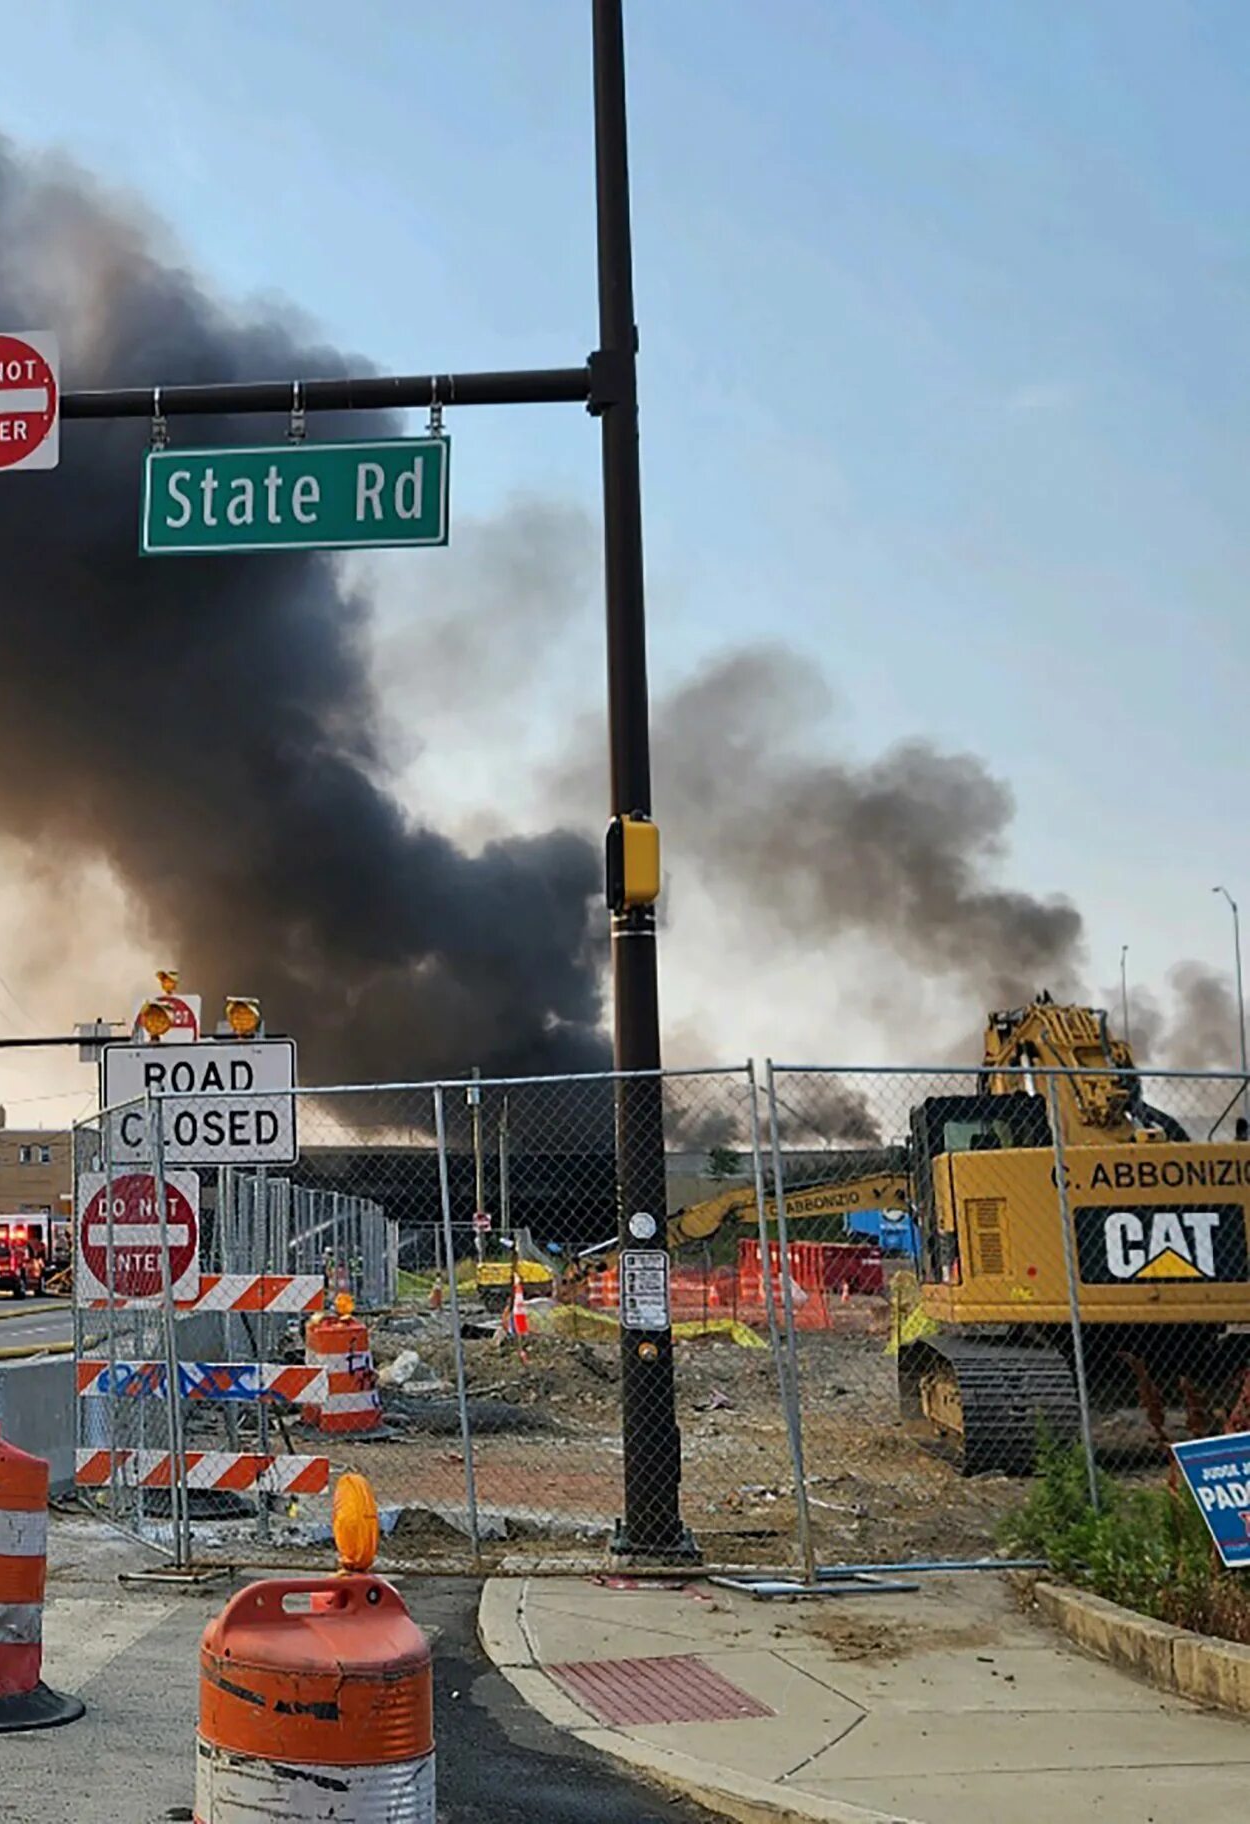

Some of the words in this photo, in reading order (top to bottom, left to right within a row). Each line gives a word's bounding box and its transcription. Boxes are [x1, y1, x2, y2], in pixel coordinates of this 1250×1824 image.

[165, 465, 321, 528] State
[355, 456, 424, 522] Rd
[144, 1060, 254, 1093] ROAD
[120, 1110, 279, 1147] COSED
[1050, 1163, 1081, 1190] C.
[1090, 1160, 1250, 1190] ABBONIZI
[98, 1198, 126, 1217] DO
[1104, 1212, 1220, 1279] CAT
[111, 1253, 162, 1273] NTE
